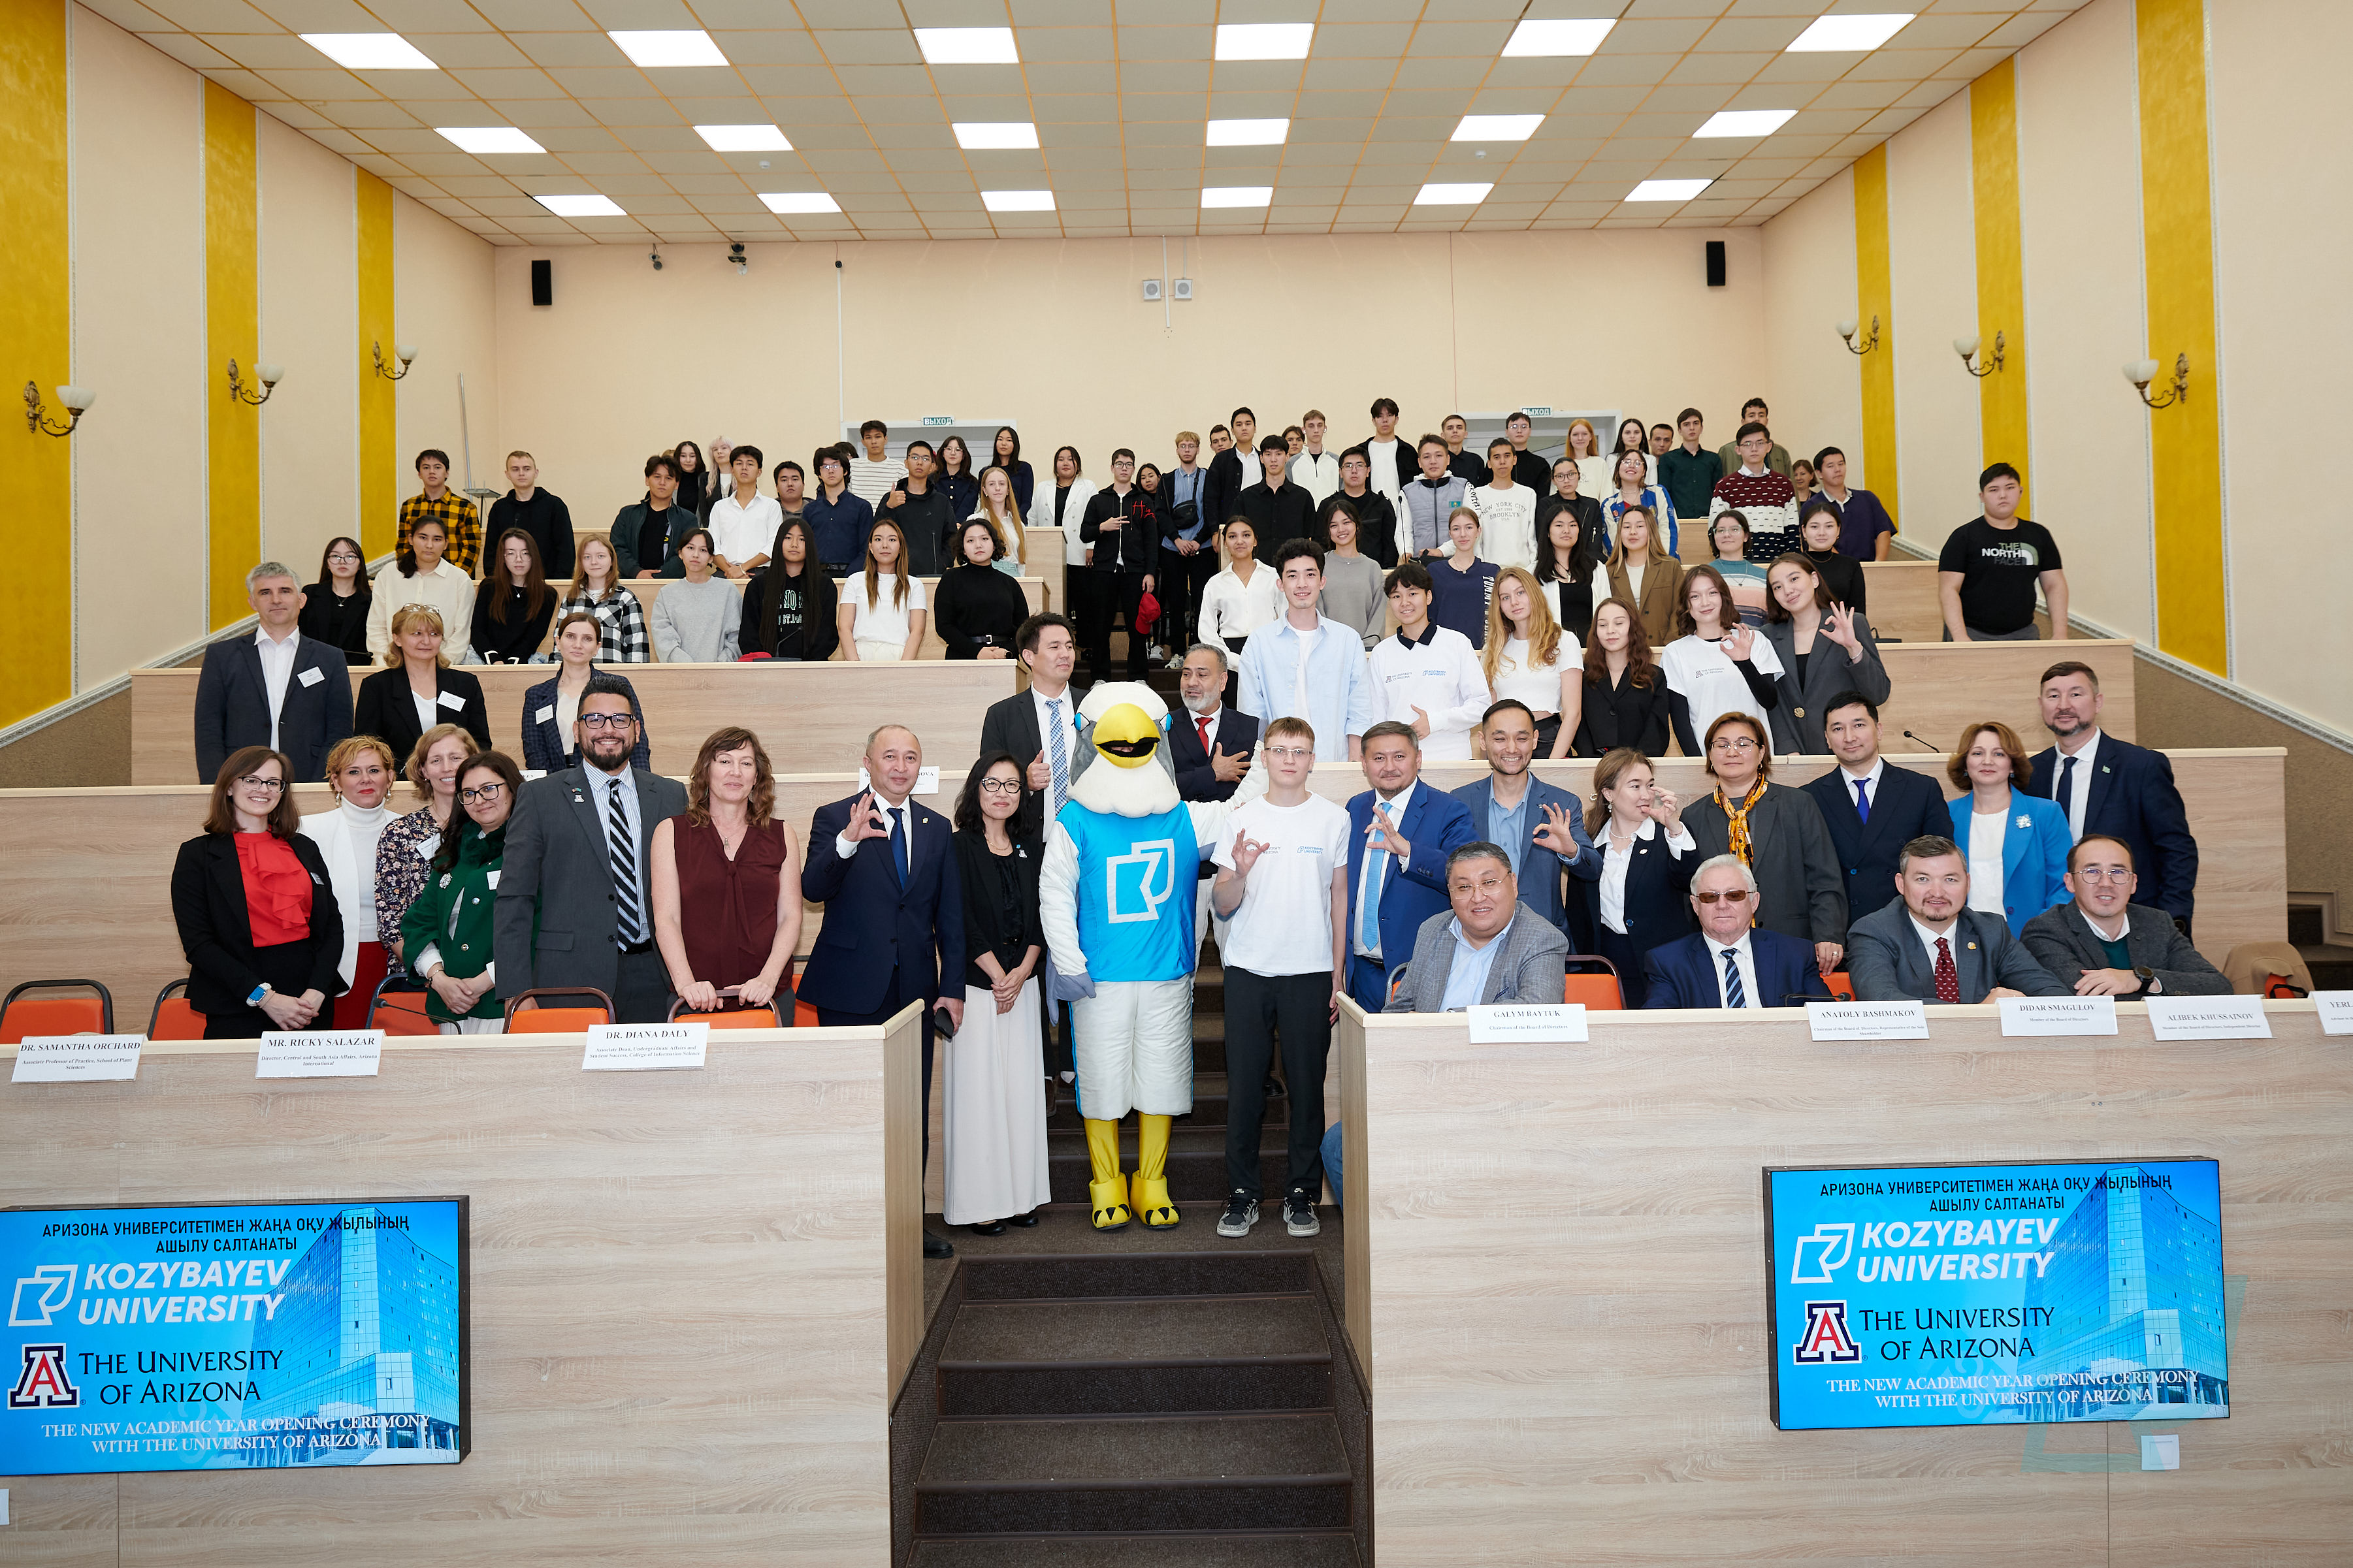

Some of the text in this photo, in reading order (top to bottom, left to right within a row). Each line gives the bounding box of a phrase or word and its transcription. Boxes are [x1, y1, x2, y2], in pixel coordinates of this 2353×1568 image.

[1482, 505, 1493, 515] NEW
[1516, 504, 1527, 513] CITY
[1982, 548, 2021, 558] NORTH
[1821, 1176, 2171, 1196] АРИЗОНА УНИВЕРСИТЕТІМЕН ЖАҢА ОҚУ ЖЫЛЫНЫҢ
[1930, 1196, 2064, 1212] АШЫЛУ САЛТАНАТЫ
[42, 1215, 410, 1237] АРИЗОНА УНИВЕРСИТЕТІМЕН ЖАҢА ОҚУ ЖЫЛЫНЫҢ
[1862, 1218, 2059, 1248] KOZYBAYEV
[156, 1237, 297, 1253] АШЫЛУ САЛТАНАТЫ
[84, 1259, 291, 1290] KOZYBAYEV
[1857, 1251, 2055, 1283] UNIVERSITY
[78, 1294, 285, 1325] UNIVERSITY
[1859, 1307, 2054, 1330] THE UNIVERSITY
[1793, 1300, 1862, 1365] A
[1881, 1336, 2035, 1360] OF ARIZONA
[78, 1350, 284, 1375] THE UNIVERSITY
[7, 1343, 80, 1410] A
[1826, 1370, 2199, 1392] THE NEW ACADEMIC YEAR OPENING CEREMONY
[100, 1379, 261, 1404] OF ARIZONA
[1875, 1388, 2152, 1407] WITH THE UNIVERSITY OF ARIZONA
[42, 1415, 430, 1437] THE NEW ACADEMIC YEAR OPENING CEREMONY
[91, 1433, 382, 1452] WITH THE UNIVERSITY OF ARIZONA
